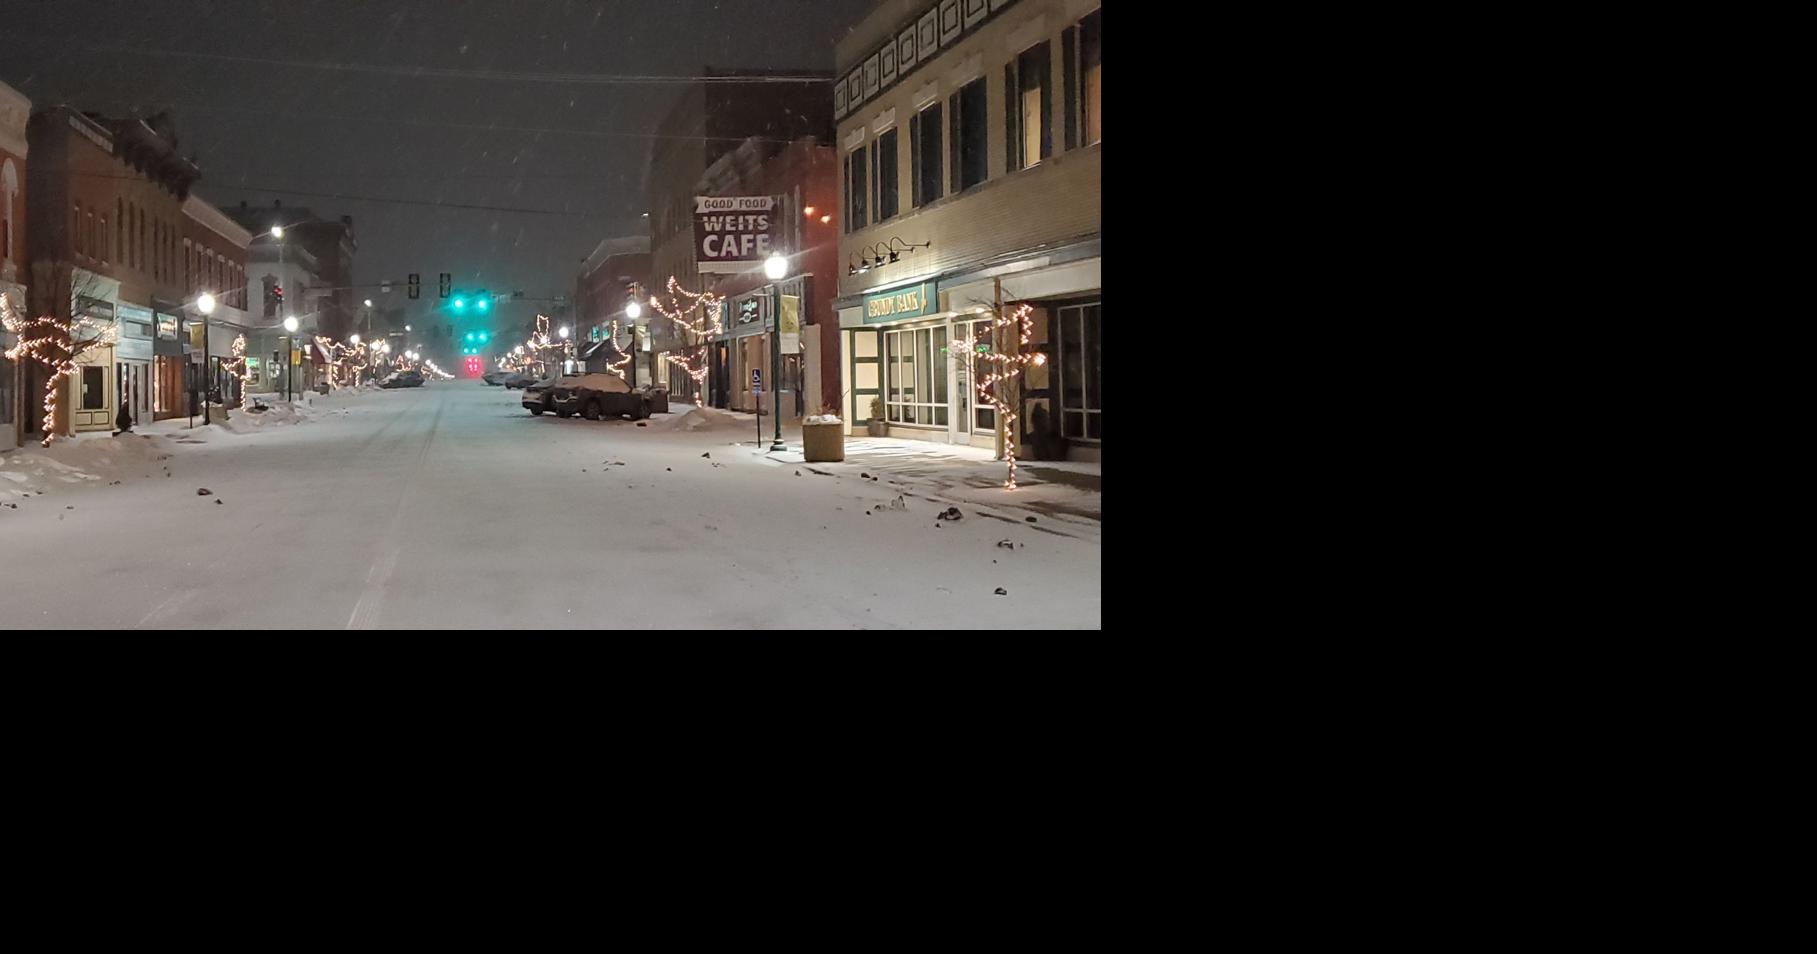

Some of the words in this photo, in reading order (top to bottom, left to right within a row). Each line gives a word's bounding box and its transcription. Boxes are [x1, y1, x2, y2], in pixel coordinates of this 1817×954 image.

[704, 199, 734, 209] GOOD
[739, 199, 767, 209] FOOD
[702, 214, 769, 232] WEITS
[702, 233, 769, 258] CAFE
[896, 291, 919, 313] BANK
